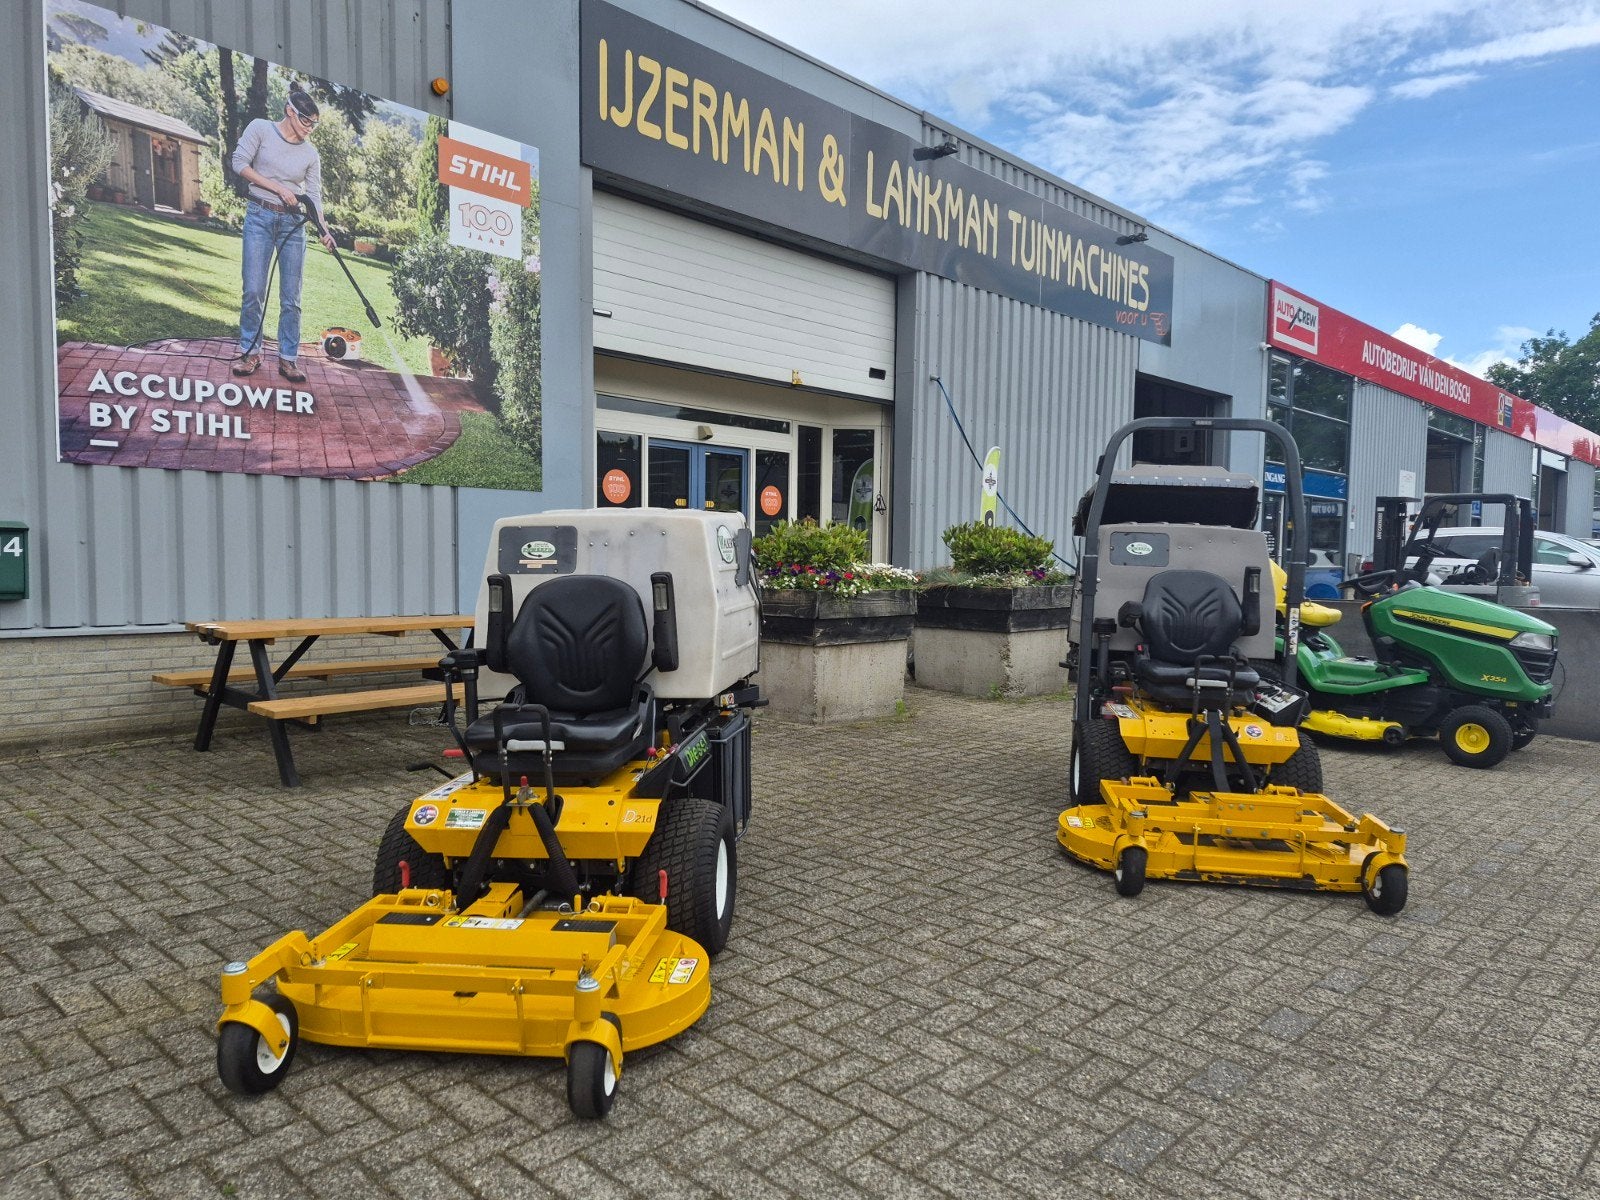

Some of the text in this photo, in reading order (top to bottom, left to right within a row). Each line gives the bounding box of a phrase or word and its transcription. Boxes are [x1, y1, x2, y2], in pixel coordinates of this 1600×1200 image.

[449, 154, 521, 191] STIHL
[600, 39, 1149, 311] IJZERMAN & LANKMAN TUINMACHINES
[459, 203, 513, 236] 100
[468, 232, 505, 246] JAAR
[1116, 310, 1138, 324] voor
[1362, 340, 1471, 404] AUTOBEDRIJF VAN DEN BOSCH
[88, 368, 314, 414] ACCUPOWER
[89, 402, 251, 440] BY STIHL
